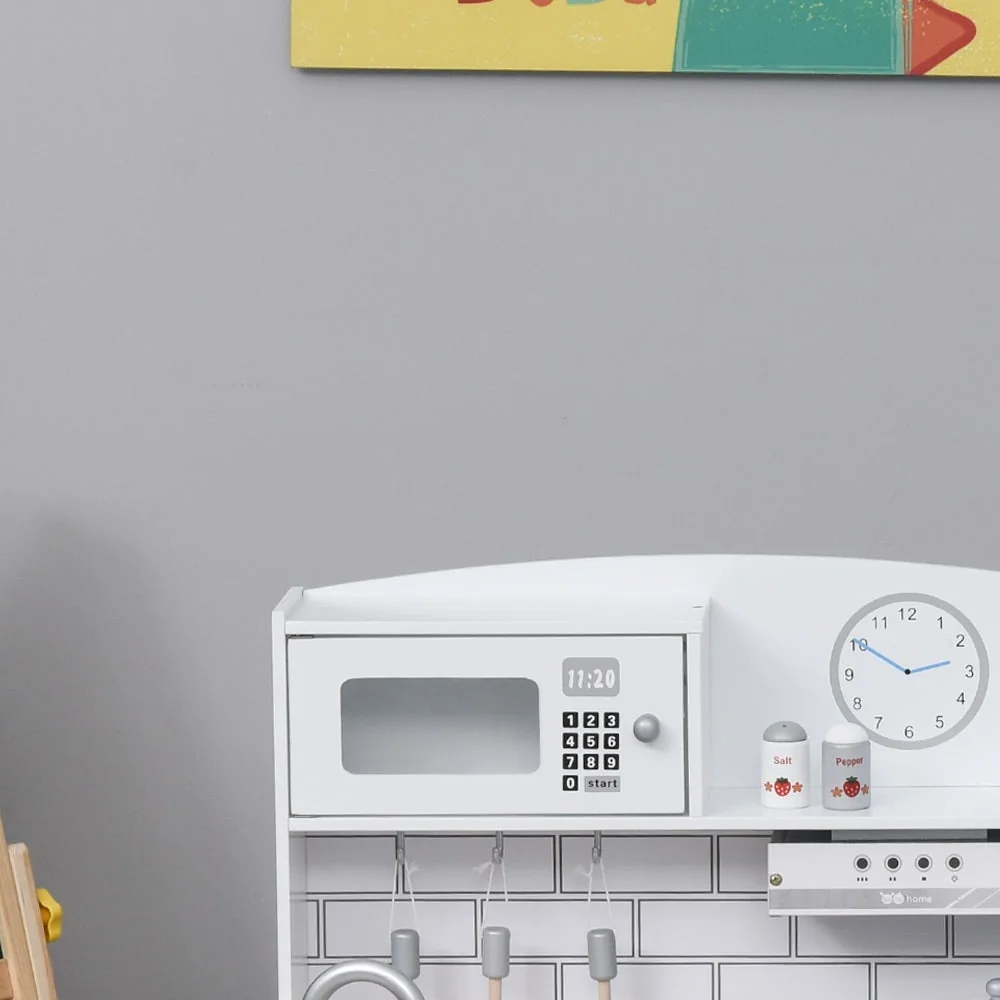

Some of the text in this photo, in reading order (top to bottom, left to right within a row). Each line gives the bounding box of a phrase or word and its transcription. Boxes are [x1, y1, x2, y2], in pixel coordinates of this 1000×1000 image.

[898, 608, 917, 621] 12
[872, 616, 887, 629] 11
[937, 616, 943, 629] 1
[850, 638, 868, 651] 10
[956, 634, 965, 647] 2
[844, 668, 854, 681] 9
[965, 665, 974, 678] 3
[567, 668, 616, 689] 11:20
[853, 697, 862, 710] 8
[956, 692, 966, 705] 4
[567, 714, 616, 727] 1 2 3
[874, 716, 883, 729] 7
[935, 715, 944, 729] 5
[904, 725, 914, 739] 6
[566, 735, 616, 748] 4 5 6
[566, 756, 616, 769] 7 8 9
[773, 756, 792, 765] Salt
[836, 757, 864, 767] Pepper
[566, 777, 618, 789] 0 start
[906, 895, 933, 904] home
